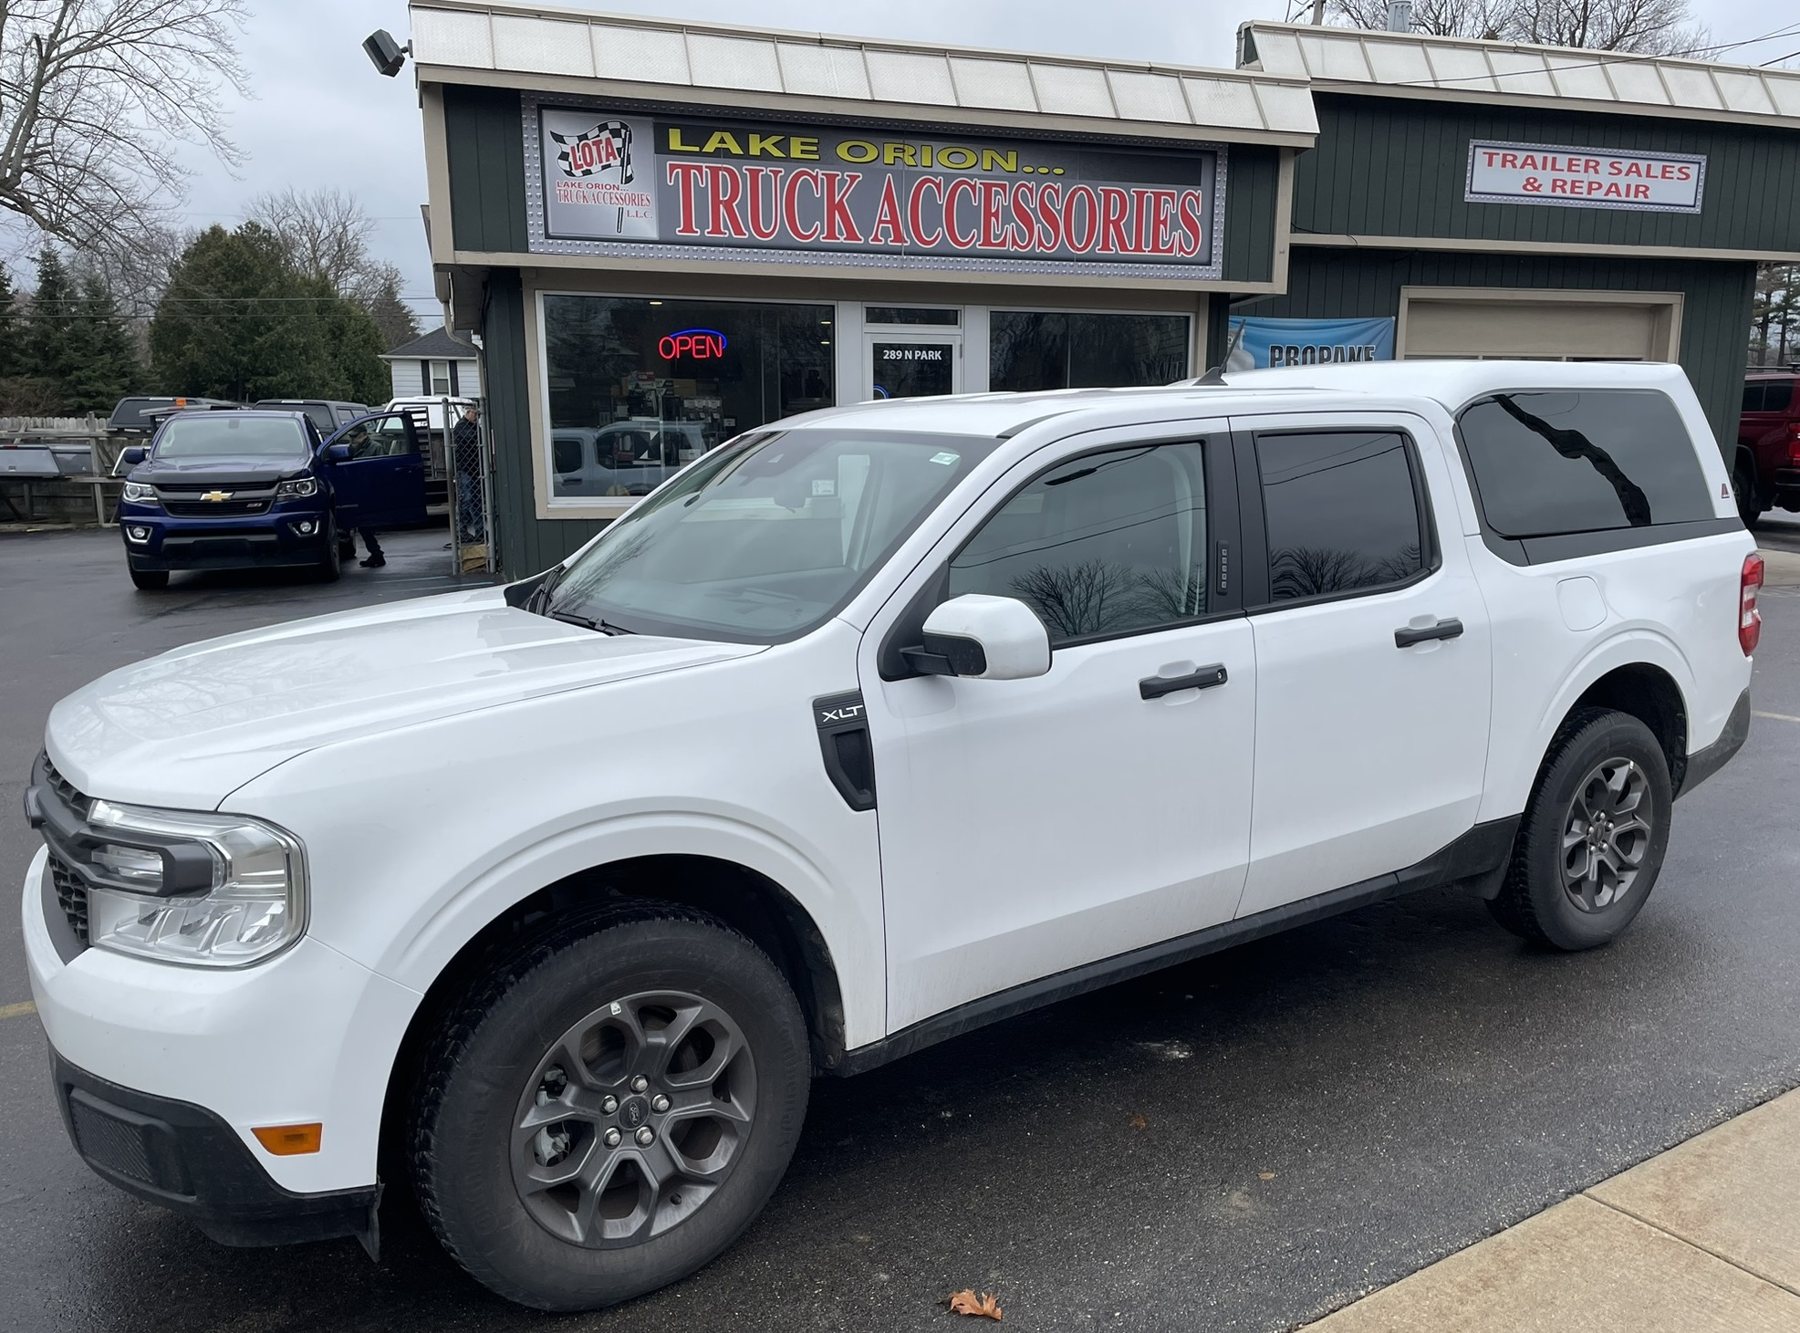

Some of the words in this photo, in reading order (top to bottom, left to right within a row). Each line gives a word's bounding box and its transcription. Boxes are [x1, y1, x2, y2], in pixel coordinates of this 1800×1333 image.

[569, 135, 619, 171] LOTA
[667, 127, 821, 161] LAKE
[835, 139, 1066, 176] ORION...
[1482, 151, 1601, 175] TRAILER
[1608, 160, 1692, 181] SALES
[557, 181, 583, 189] LAKE
[1521, 176, 1543, 193] &
[1550, 178, 1650, 199] REPAIR
[557, 189, 589, 204] TRUCK
[592, 191, 651, 207] ACCESSORIES
[667, 161, 865, 245] TRUCK
[869, 173, 1203, 257] ACCESSORIES
[626, 210, 653, 219] L.L.C.
[658, 335, 723, 360] OPEN
[883, 349, 903, 360] 289
[904, 350, 913, 360] N
[914, 350, 942, 360] PARK
[822, 704, 864, 723] XLT
